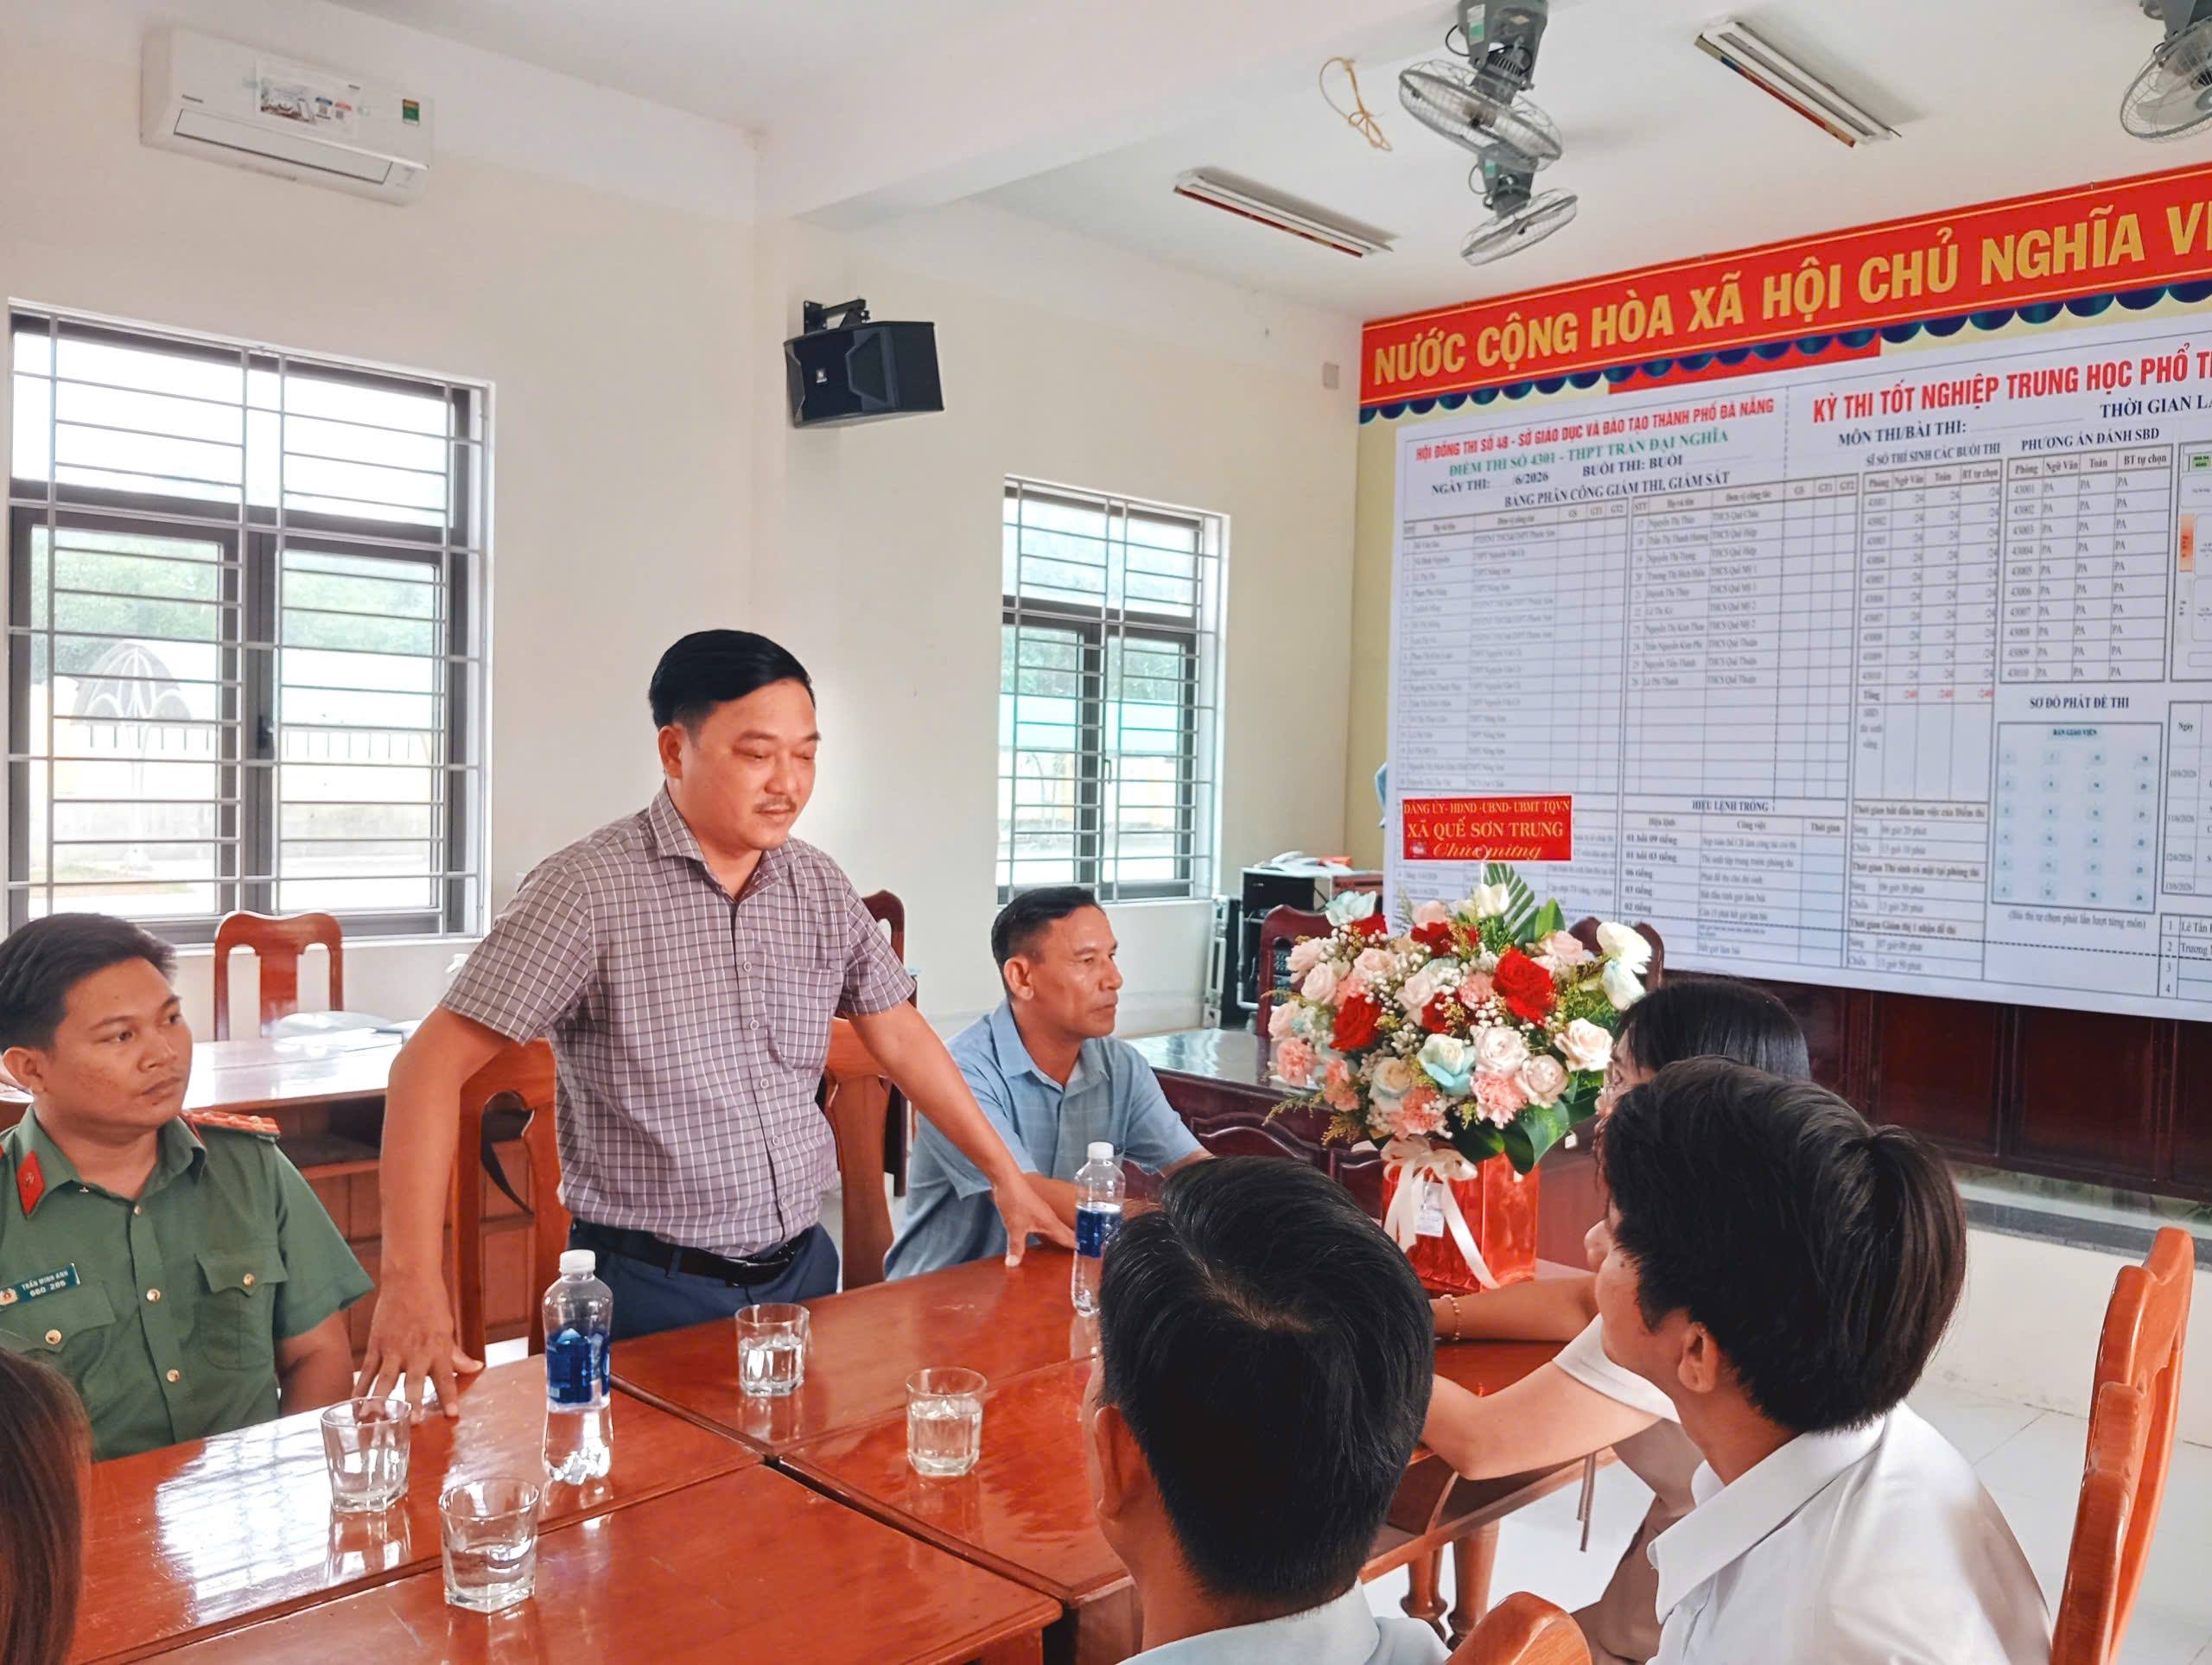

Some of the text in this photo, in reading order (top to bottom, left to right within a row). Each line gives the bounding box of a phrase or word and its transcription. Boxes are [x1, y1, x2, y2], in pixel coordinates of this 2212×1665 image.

[1374, 327, 1466, 385] NƯỚC
[1477, 312, 1579, 371] CỘNG
[1591, 289, 1674, 349] HÒA
[1688, 270, 1745, 333] XÃ
[1762, 256, 1842, 323] HỘI
[1858, 226, 1959, 304] CHỦ
[1980, 204, 2146, 285] NGHĨA
[1813, 392, 1838, 423] KỲ
[1843, 392, 1873, 419] THI
[1879, 379, 1915, 415] TỐT
[1921, 373, 1999, 410] NGHIỆP
[2006, 366, 2079, 400] TRUNG
[2086, 359, 2133, 395] HỌC
[2140, 342, 2190, 385] PHỔ
[2100, 397, 2143, 418] THỜI
[2147, 395, 2191, 415] GIAN
[1463, 441, 1478, 456] THI
[1653, 408, 1689, 429] THÀNH
[1838, 429, 1872, 448] MÔN
[1934, 419, 1967, 436] THI:
[2021, 435, 2074, 451] PHƯƠNG
[1485, 457, 1507, 473] THI
[1567, 446, 1603, 462] THPT
[1680, 426, 1729, 447] NGHĨA
[1984, 442, 2000, 455] THI
[2124, 454, 2136, 466] BT
[1570, 484, 1604, 500] CÔNG
[2111, 696, 2129, 709] THI
[1408, 816, 1563, 841] XÃ QUẾ SƠN TRUNG
[2165, 982, 2171, 993] 4
